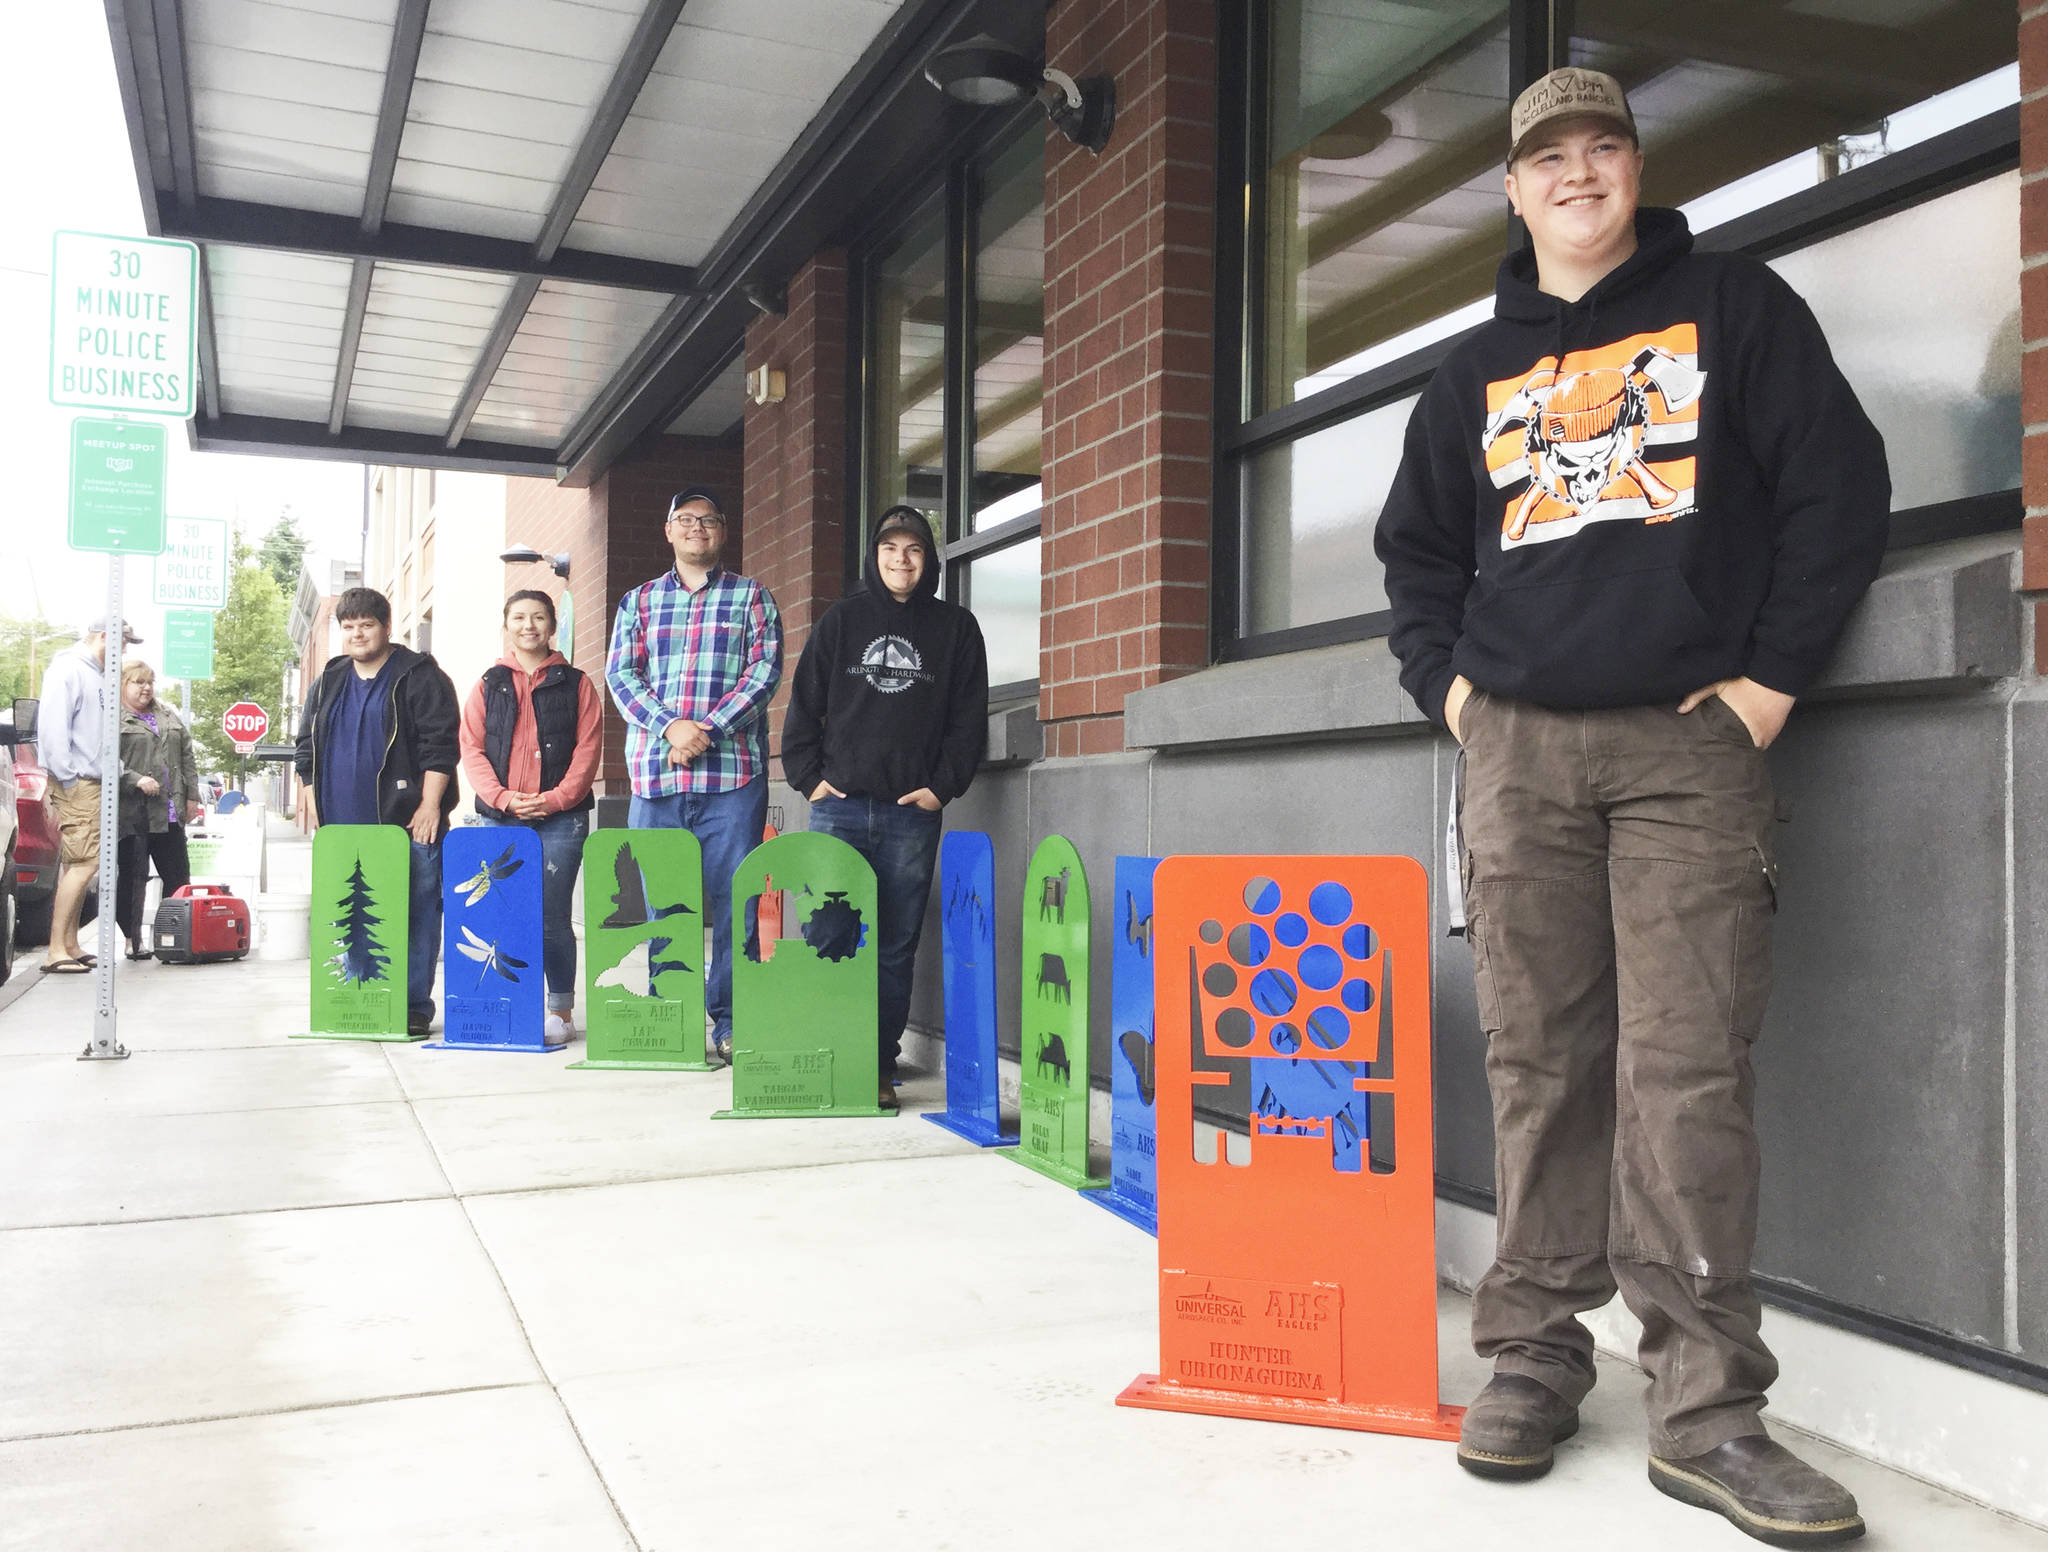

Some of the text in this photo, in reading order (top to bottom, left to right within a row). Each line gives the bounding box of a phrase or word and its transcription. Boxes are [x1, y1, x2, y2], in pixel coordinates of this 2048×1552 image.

[1523, 89, 1549, 114] JIM
[110, 250, 141, 279] 30
[77, 287, 170, 322] MINUTE
[78, 327, 167, 361] POLICE
[62, 365, 180, 402] BUSINESS
[83, 439, 157, 452] MEETUP SPOT
[184, 524, 200, 539] 30
[166, 544, 214, 560] MINUTE
[167, 564, 213, 580] POLICE
[159, 584, 219, 601] BUSINESS
[847, 665, 936, 682] ARLINGT HARDWARE
[226, 714, 266, 731] STOP
[1044, 1097, 1061, 1118] AHS
[1137, 1132, 1156, 1157] AHS
[1175, 1299, 1248, 1319] UNIVERSAL
[1265, 1290, 1331, 1321] AHS
[1277, 1318, 1319, 1332] EAGLES
[1209, 1341, 1294, 1366] HUNTER
[1179, 1360, 1326, 1391] URIONAGUENA
